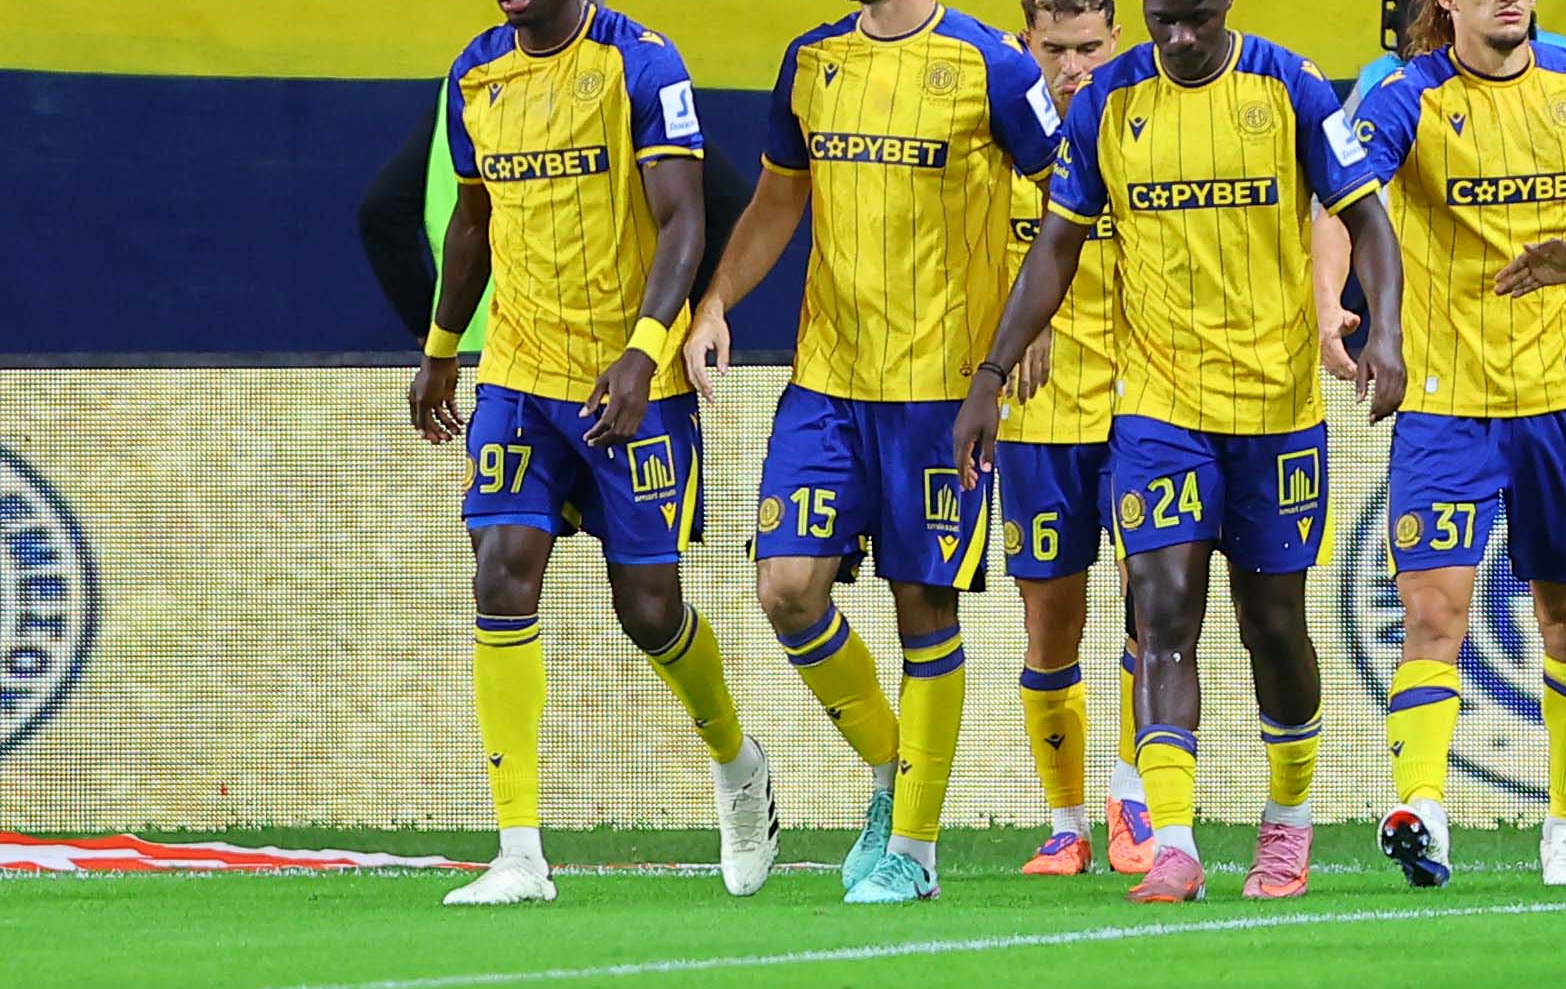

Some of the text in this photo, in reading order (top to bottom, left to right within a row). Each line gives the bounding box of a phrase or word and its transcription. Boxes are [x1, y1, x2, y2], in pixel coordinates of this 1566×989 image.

[485, 148, 602, 180] COPYBET
[811, 135, 942, 165] COPYBET
[1132, 180, 1272, 209] COPYBET
[480, 443, 532, 494] 97
[790, 487, 837, 538] 15
[1148, 471, 1203, 528] 24
[1033, 512, 1058, 561] 6
[1430, 502, 1477, 550] 37
